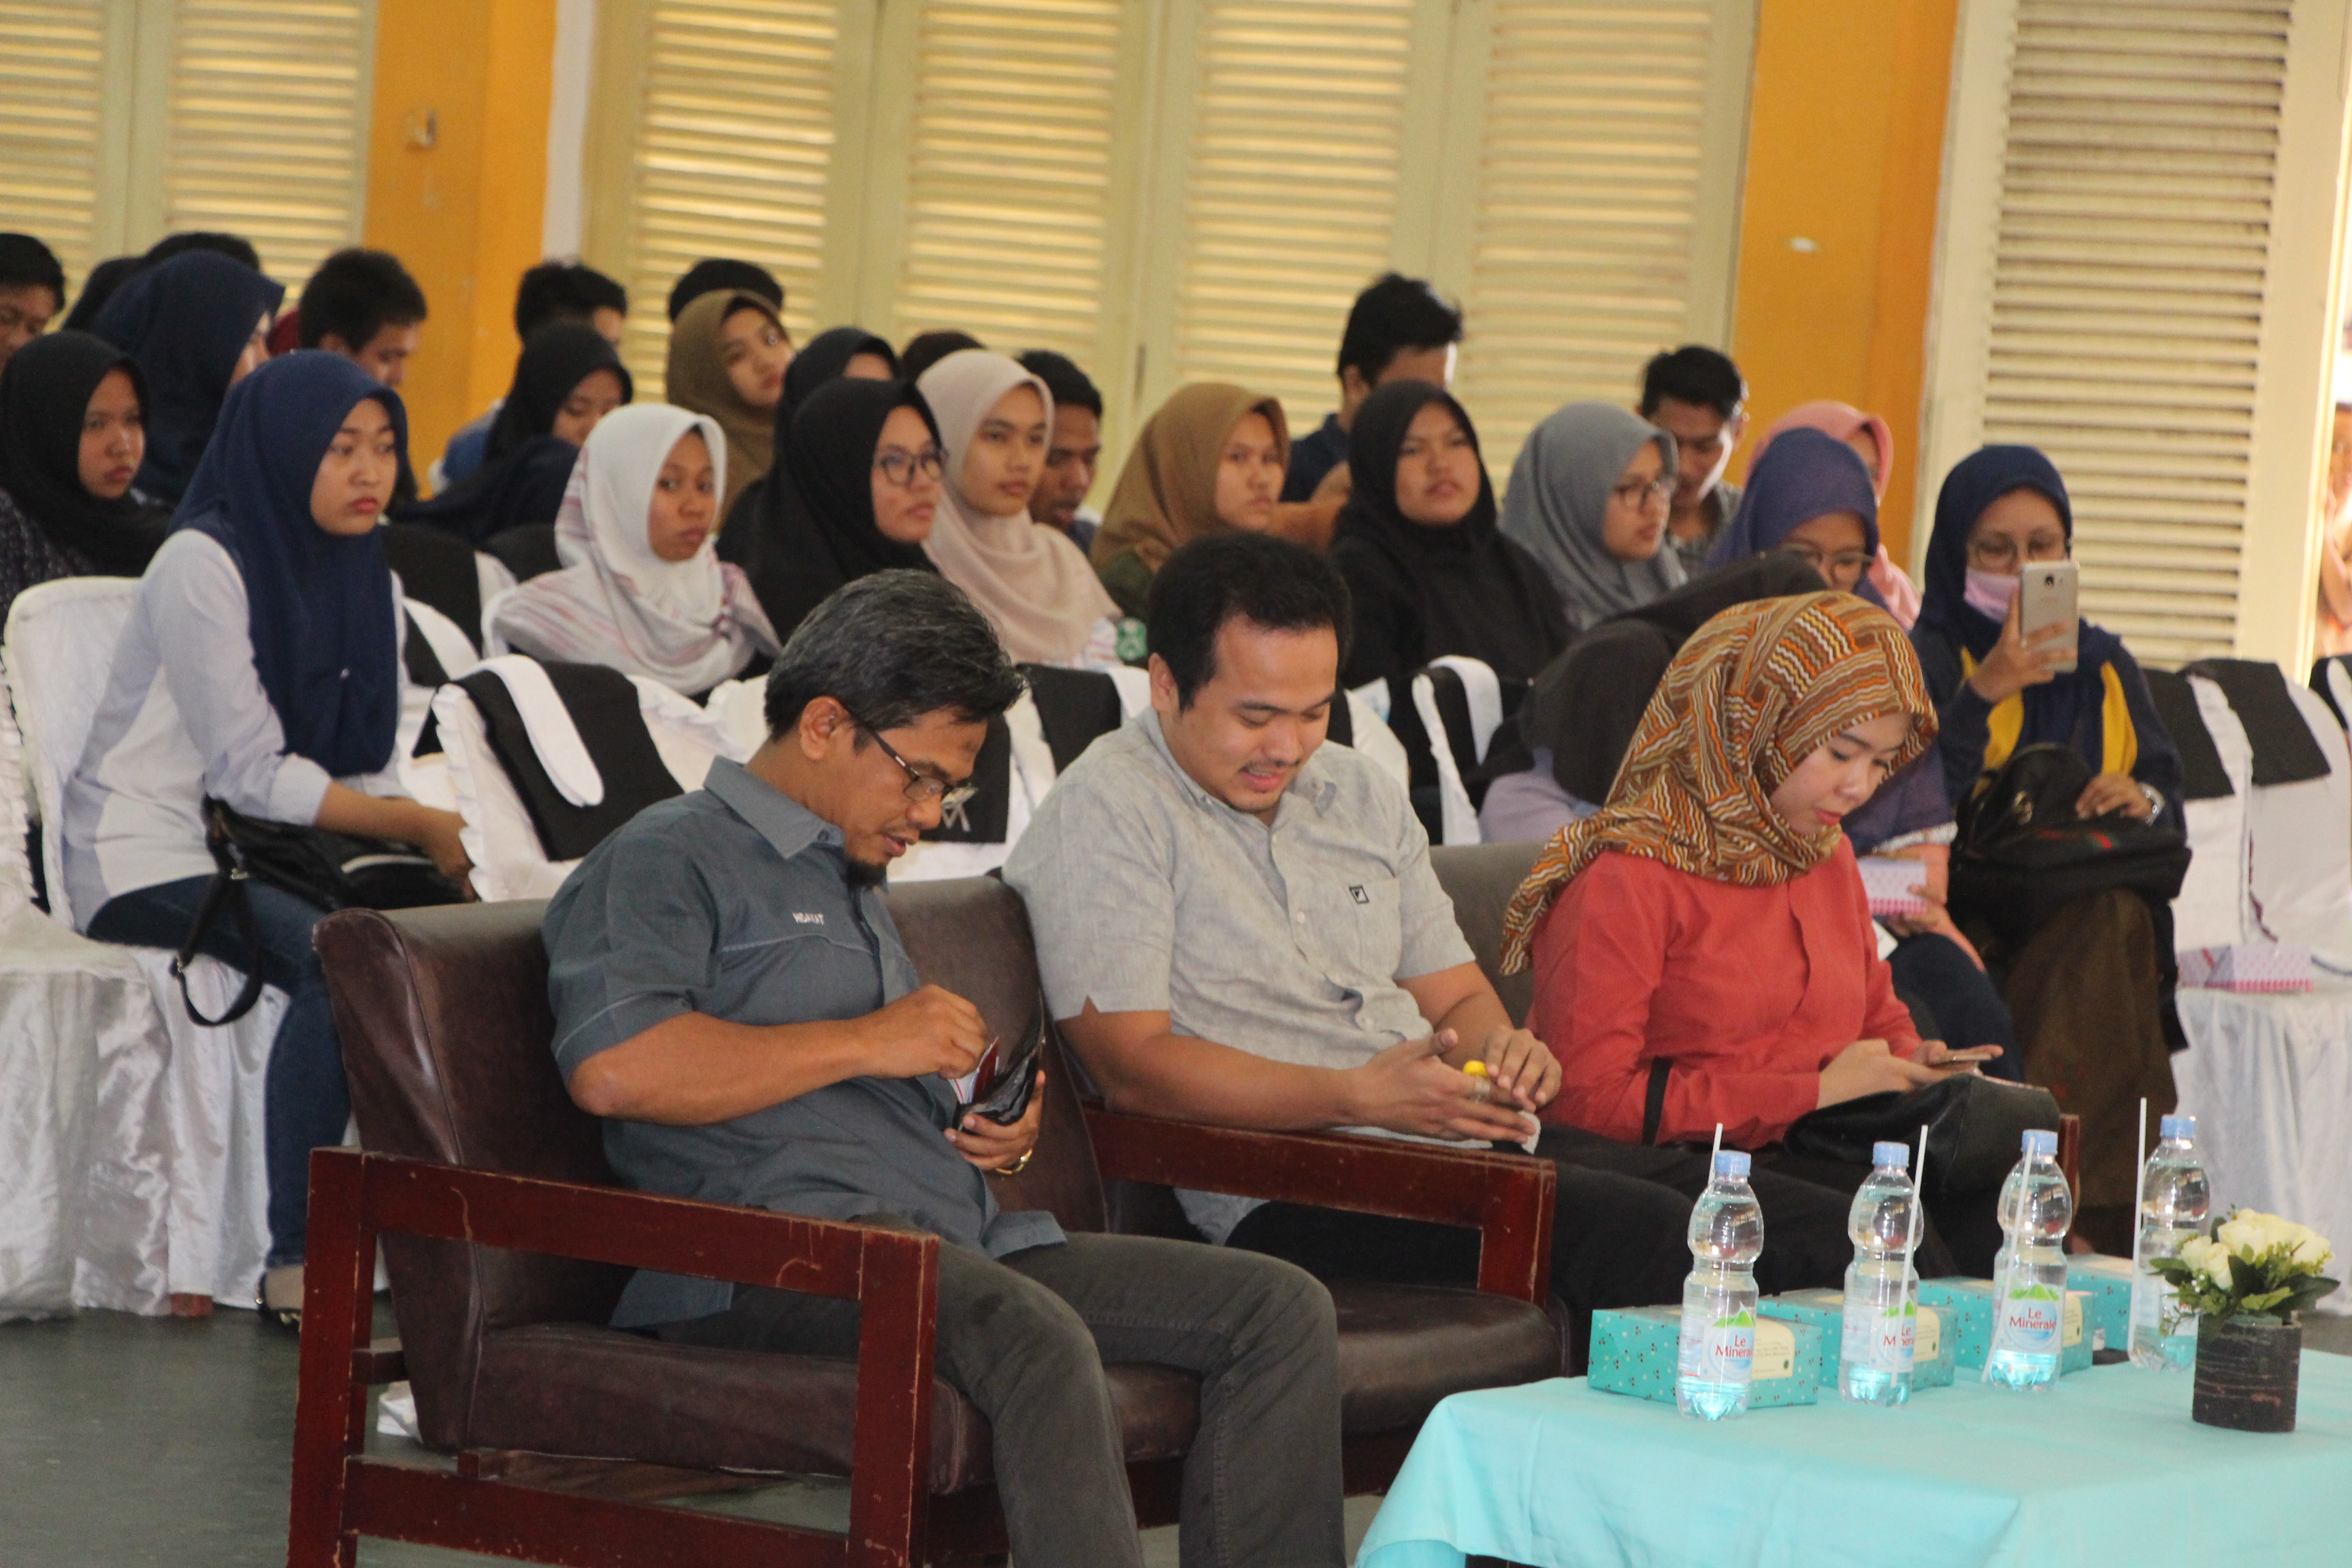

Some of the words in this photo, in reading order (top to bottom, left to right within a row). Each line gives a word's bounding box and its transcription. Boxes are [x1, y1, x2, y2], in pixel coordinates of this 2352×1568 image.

[2029, 1306, 2042, 1319] Le
[2010, 1316, 2057, 1329] Minerale
[1735, 1335, 1746, 1347] Le
